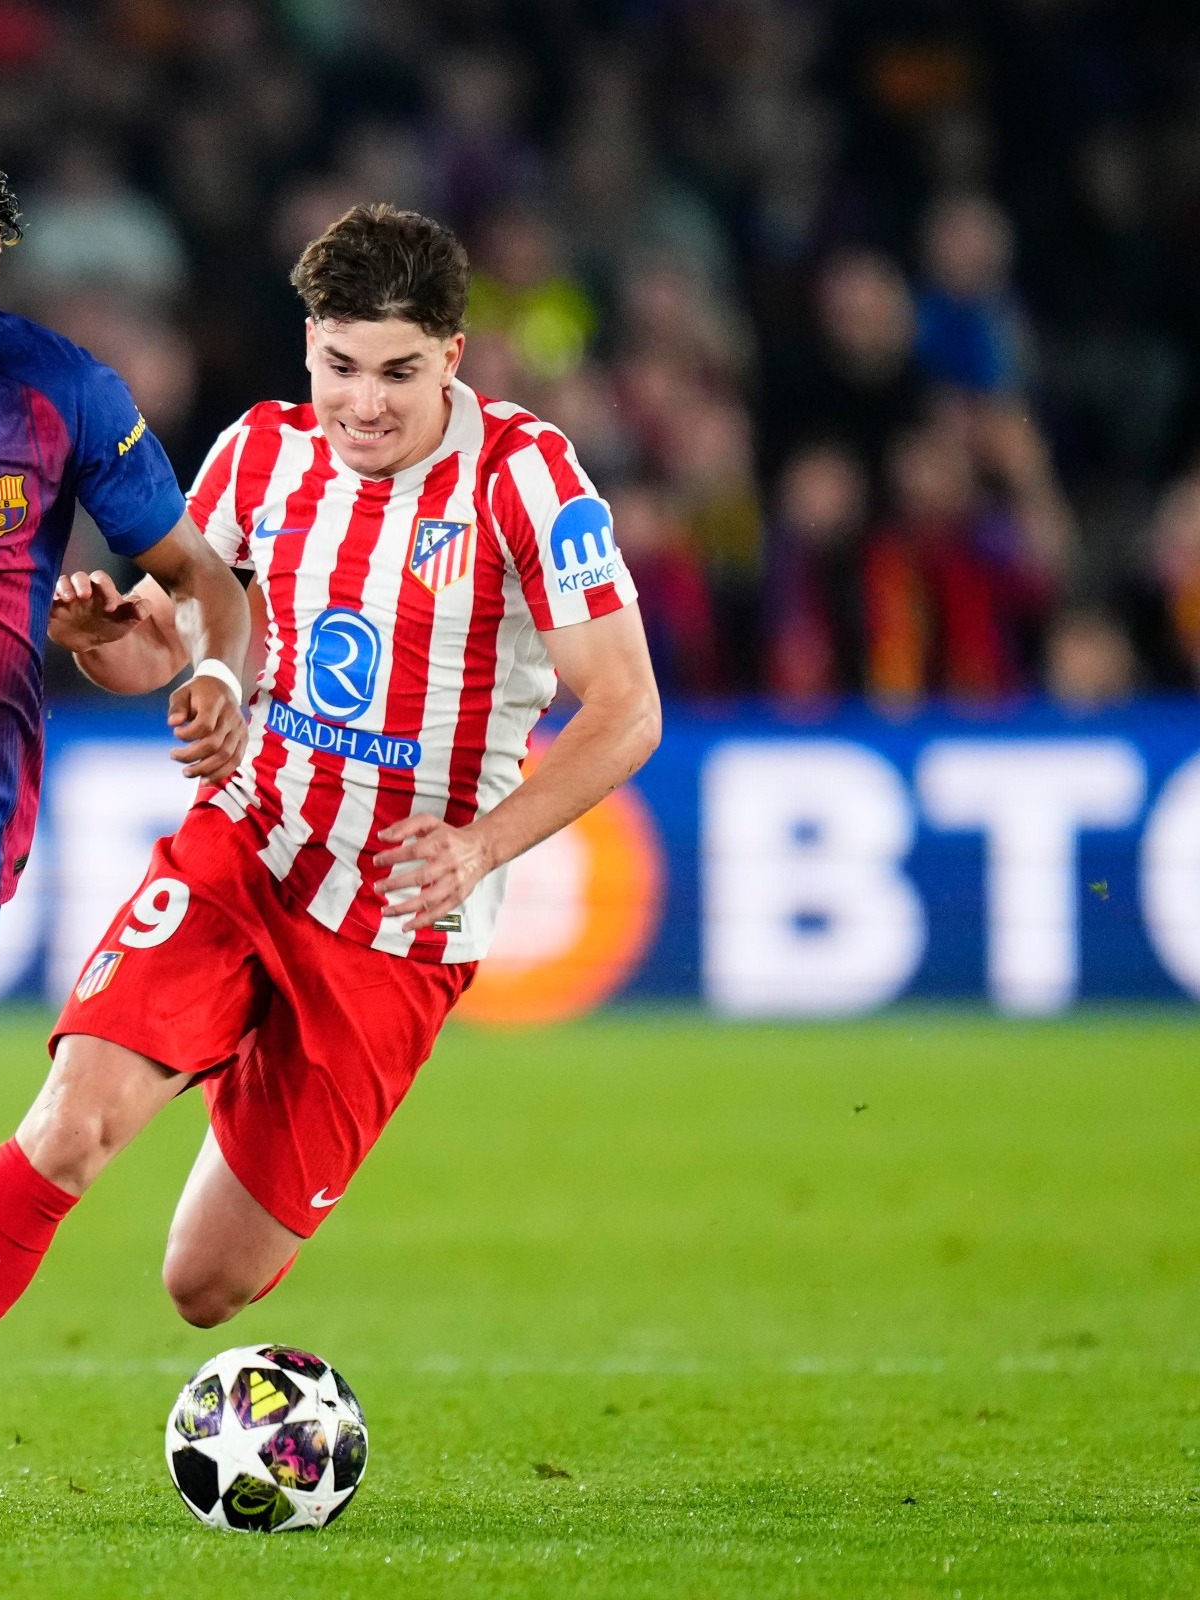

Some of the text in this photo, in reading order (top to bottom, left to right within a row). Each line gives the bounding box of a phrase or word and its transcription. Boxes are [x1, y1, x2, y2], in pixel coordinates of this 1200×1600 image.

[271, 703, 416, 766] RIYADH AIR
[118, 877, 191, 949] 9
